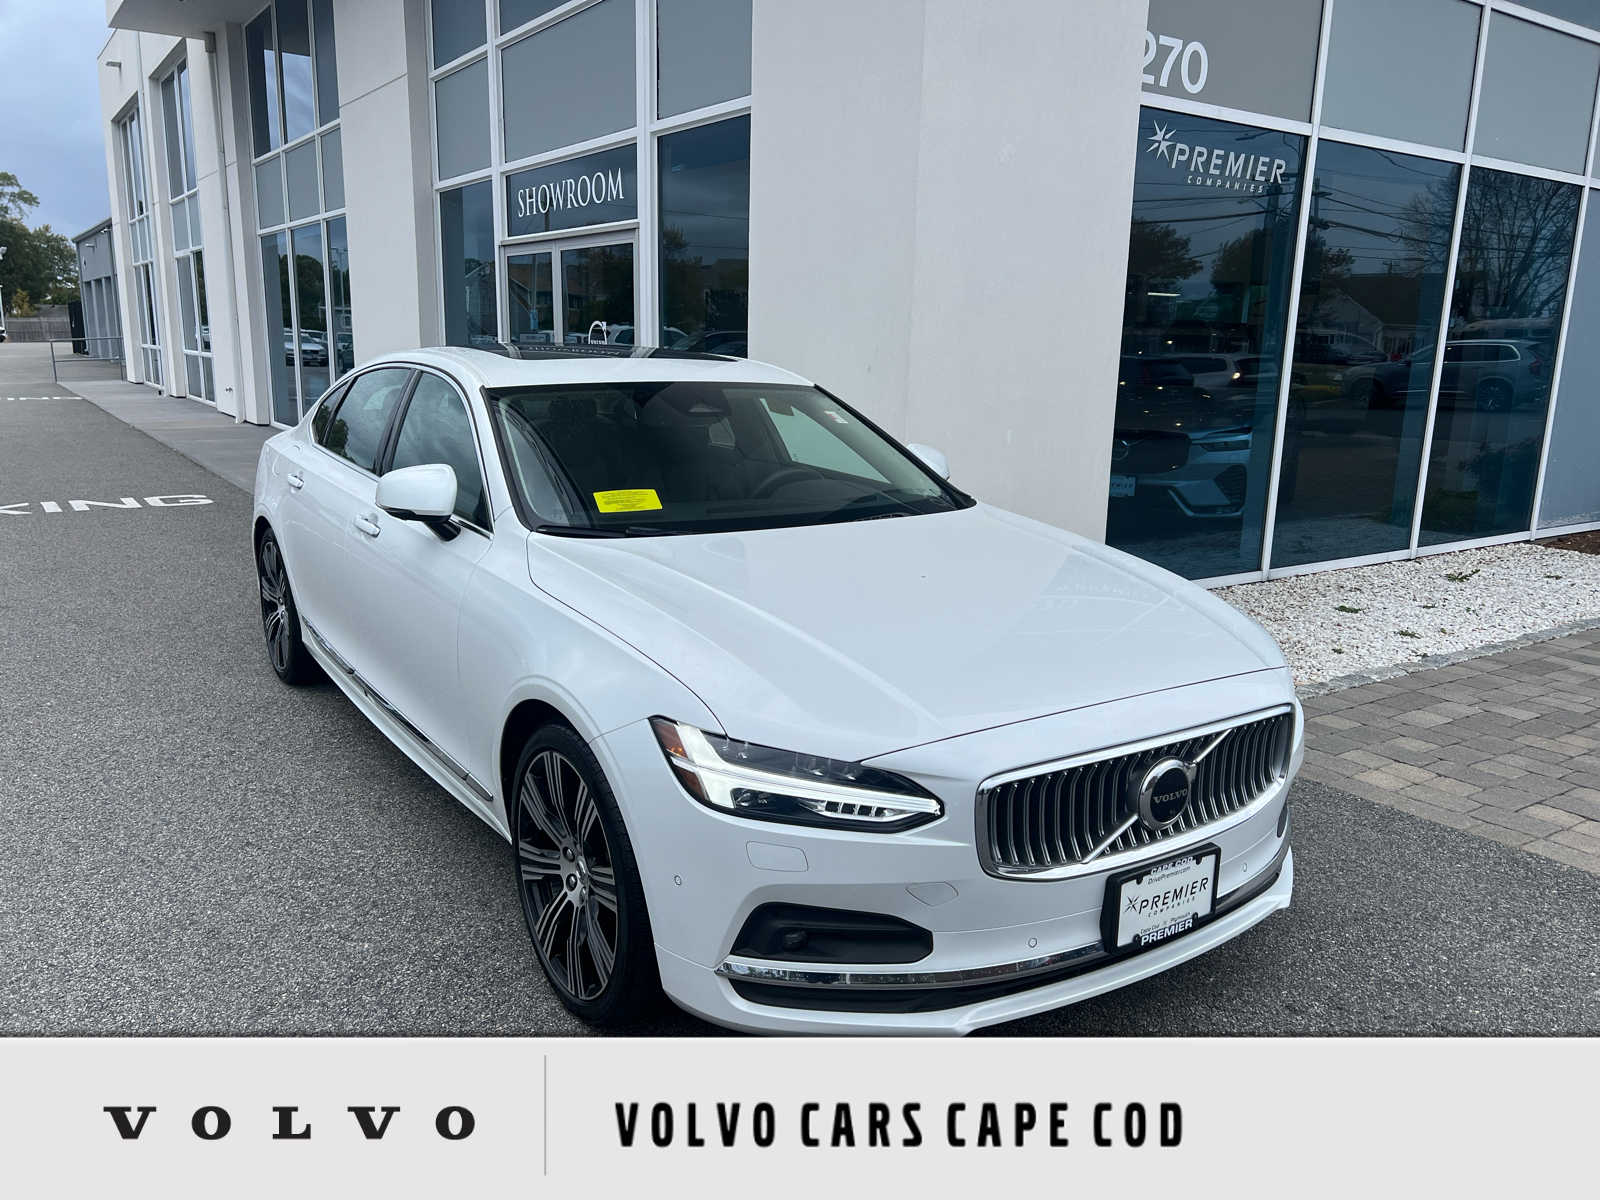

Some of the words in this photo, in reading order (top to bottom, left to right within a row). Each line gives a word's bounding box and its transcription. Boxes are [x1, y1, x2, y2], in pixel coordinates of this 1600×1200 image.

[1172, 143, 1286, 184] PREMIER
[518, 168, 624, 217] SHOWROOM
[1187, 175, 1264, 193] COMPANIES
[1152, 788, 1187, 803] VOLVO
[1139, 877, 1209, 914] PREMIER
[1141, 918, 1193, 946] PREMIER
